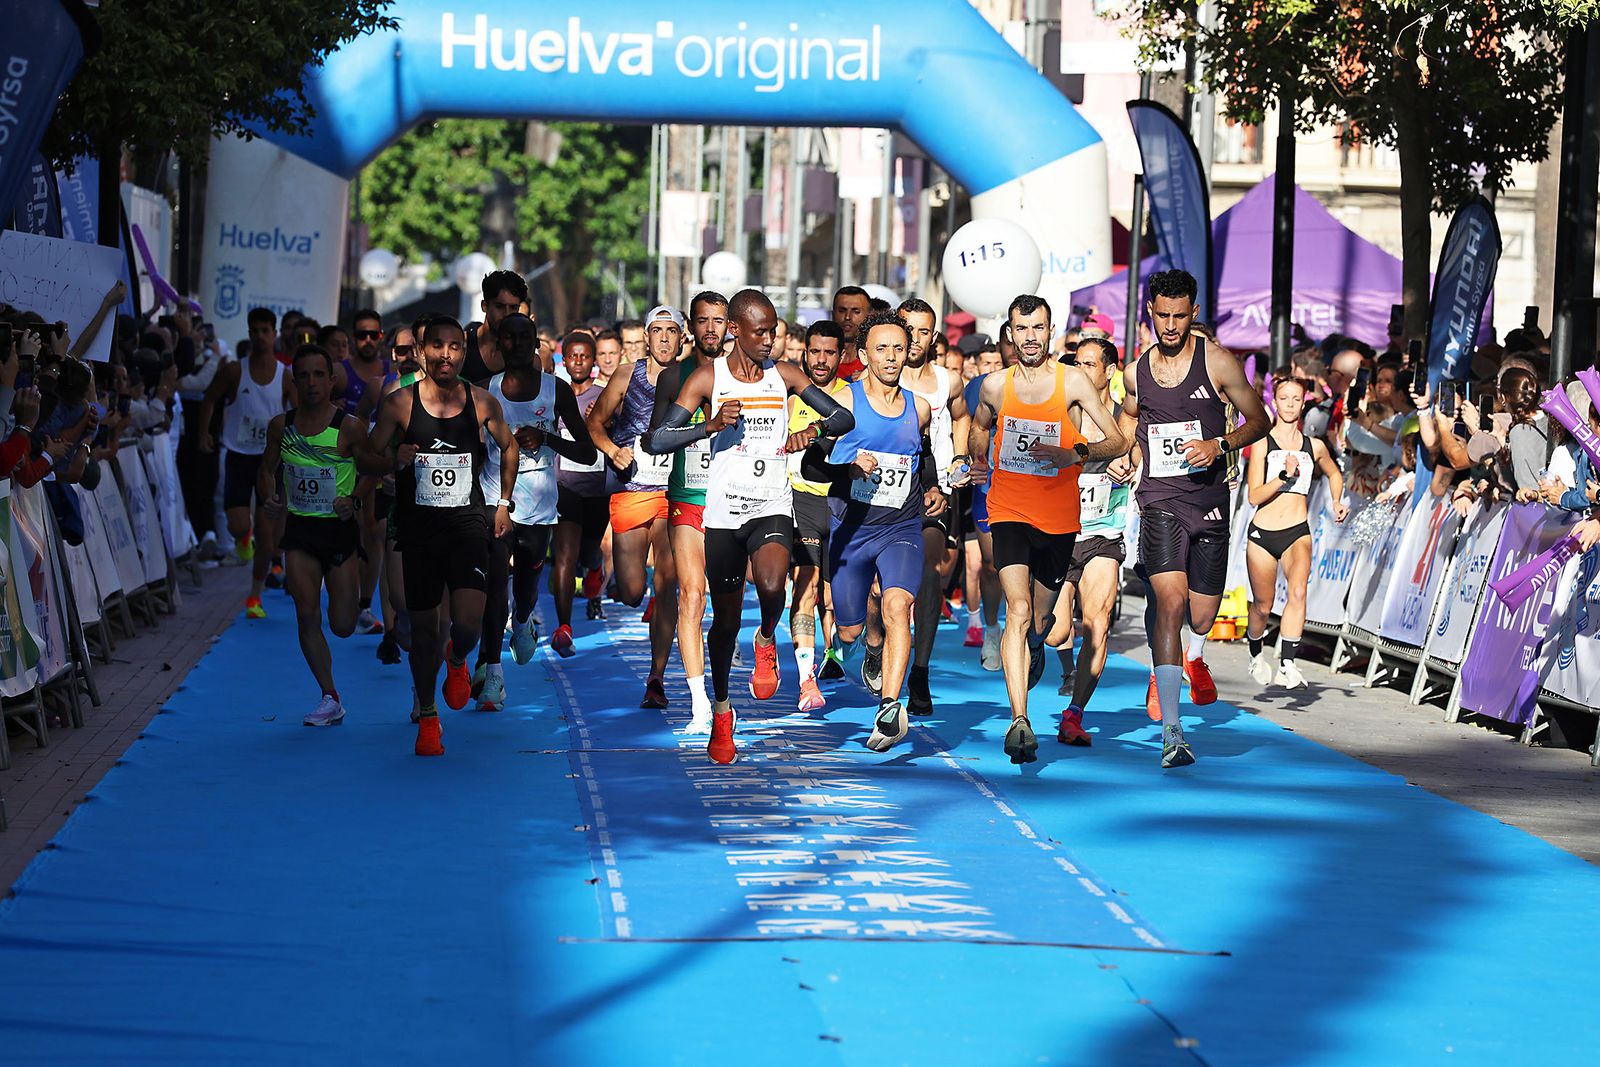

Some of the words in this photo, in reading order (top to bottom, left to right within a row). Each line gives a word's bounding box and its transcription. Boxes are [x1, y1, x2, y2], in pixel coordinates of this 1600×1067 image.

[440, 12, 653, 76] Huelva
[674, 21, 881, 92] original
[219, 222, 313, 254] Huelva
[958, 242, 1006, 267] 1:15
[1041, 251, 1087, 273] elva
[1471, 260, 1486, 305] Syrsa
[1441, 216, 1483, 380] HYUNDAI
[1241, 303, 1342, 327] AVTEL
[746, 417, 776, 425] VICKY
[1162, 437, 1186, 456] 56
[652, 453, 669, 468] 12
[753, 459, 766, 477] 9
[1001, 458, 1026, 469] Huelva
[297, 479, 319, 495] 49
[431, 469, 457, 487] 69
[863, 467, 908, 488] 337
